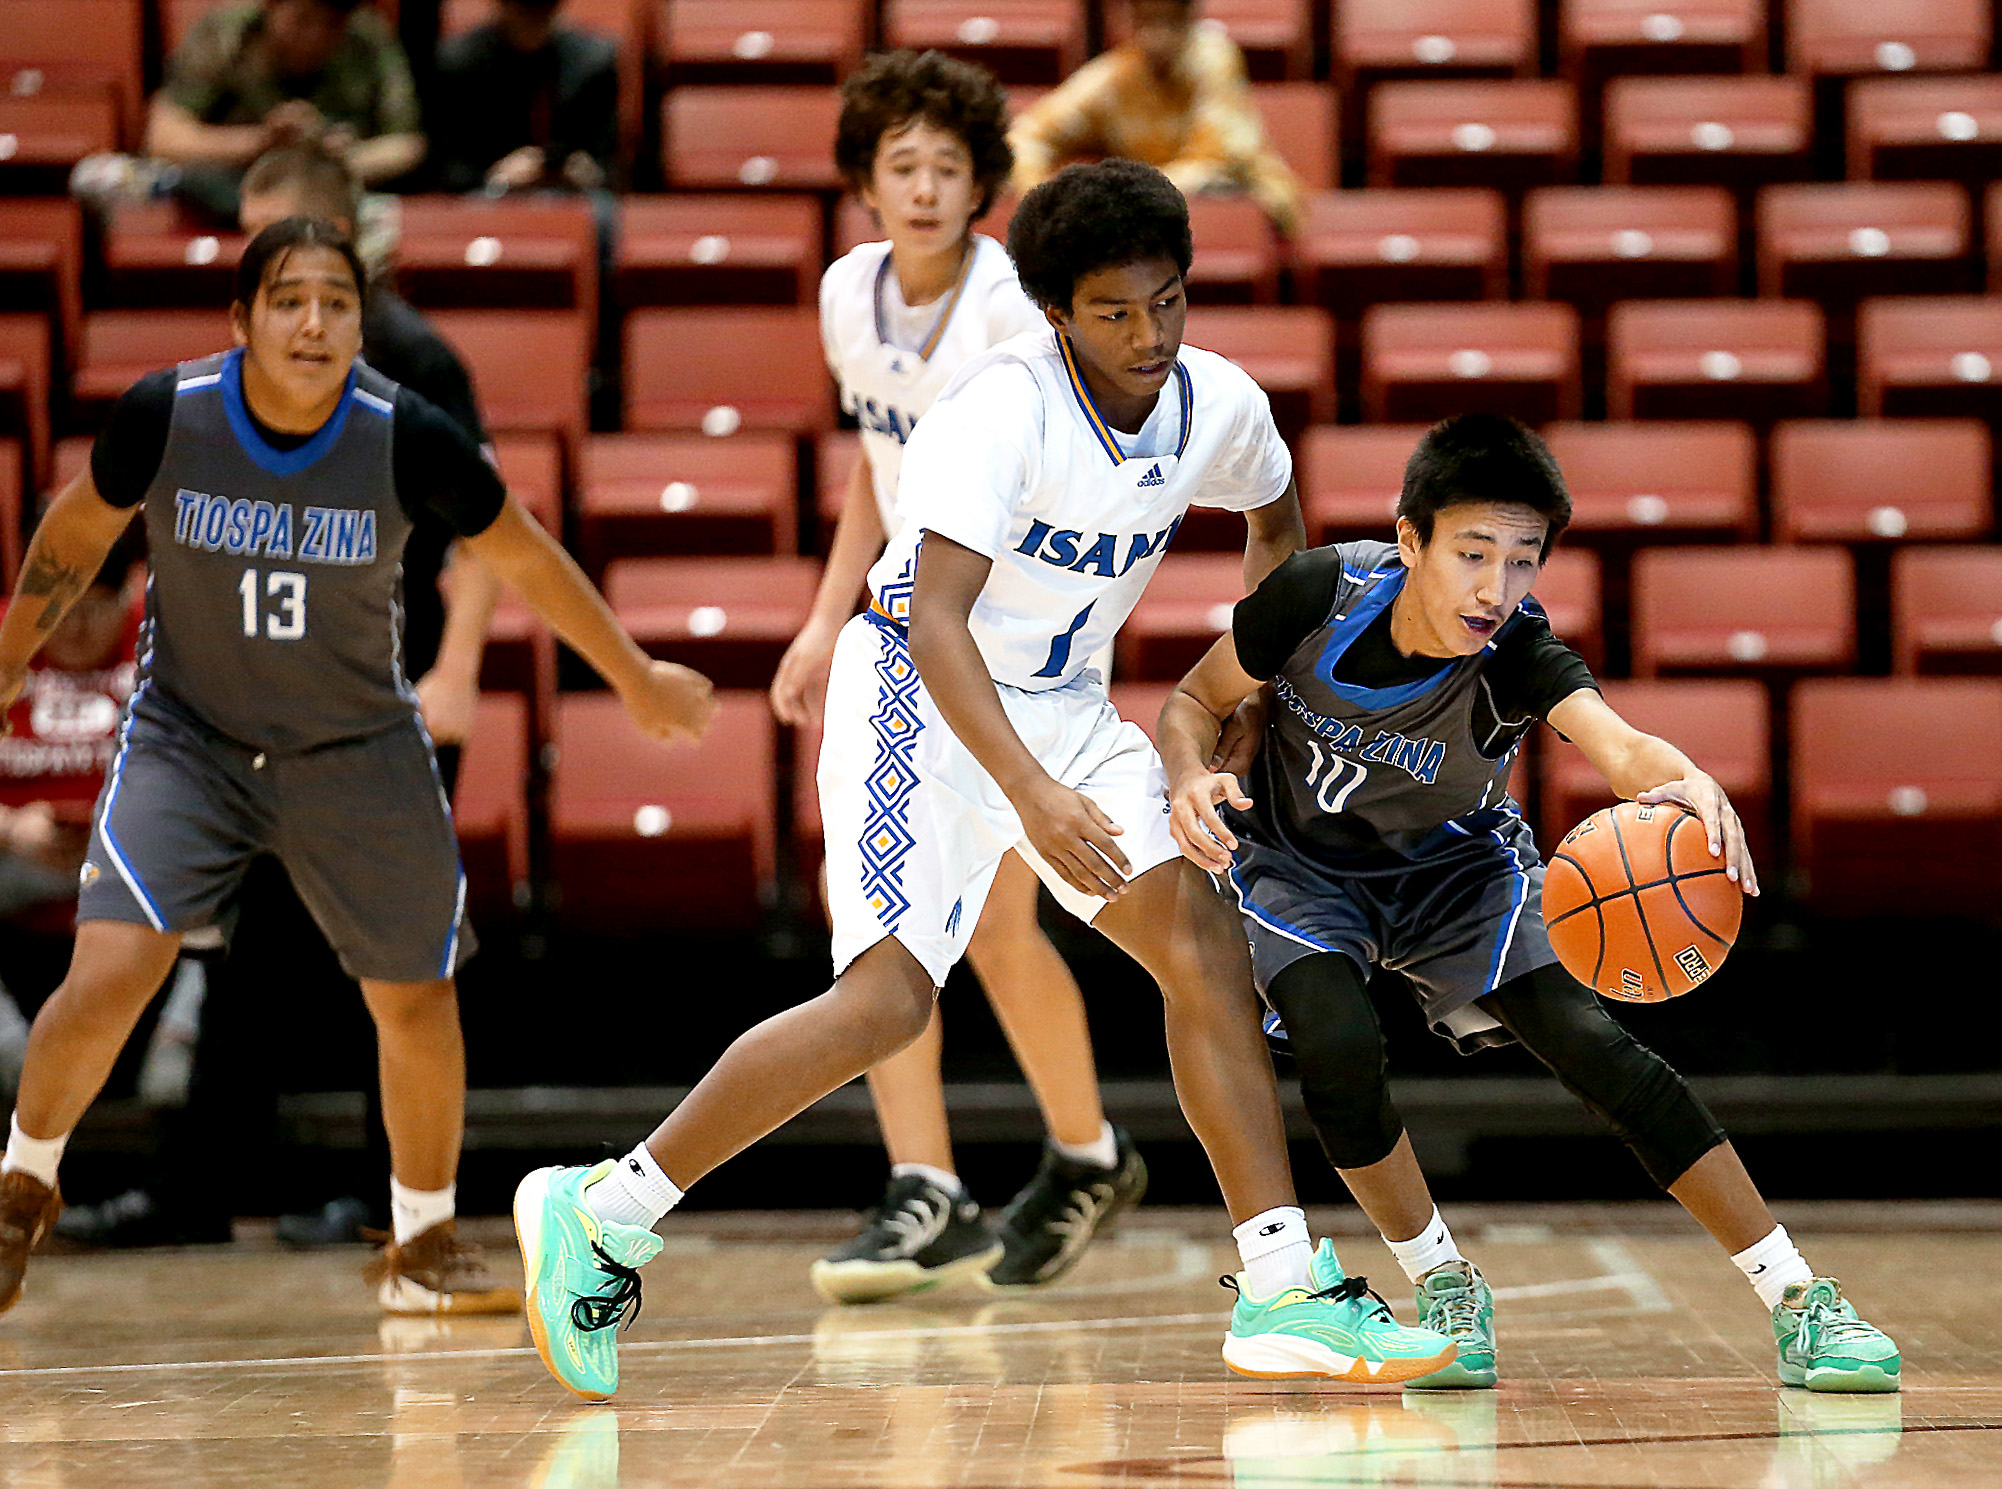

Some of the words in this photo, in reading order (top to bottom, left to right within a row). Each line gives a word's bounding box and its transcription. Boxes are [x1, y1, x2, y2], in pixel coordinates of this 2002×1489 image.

[174, 488, 293, 560] TIOSPA
[297, 506, 377, 566] ZINA
[238, 568, 307, 641] 13
[1030, 597, 1098, 678] 1
[1305, 740, 1368, 814] 10
[1359, 730, 1446, 785] ZINA
